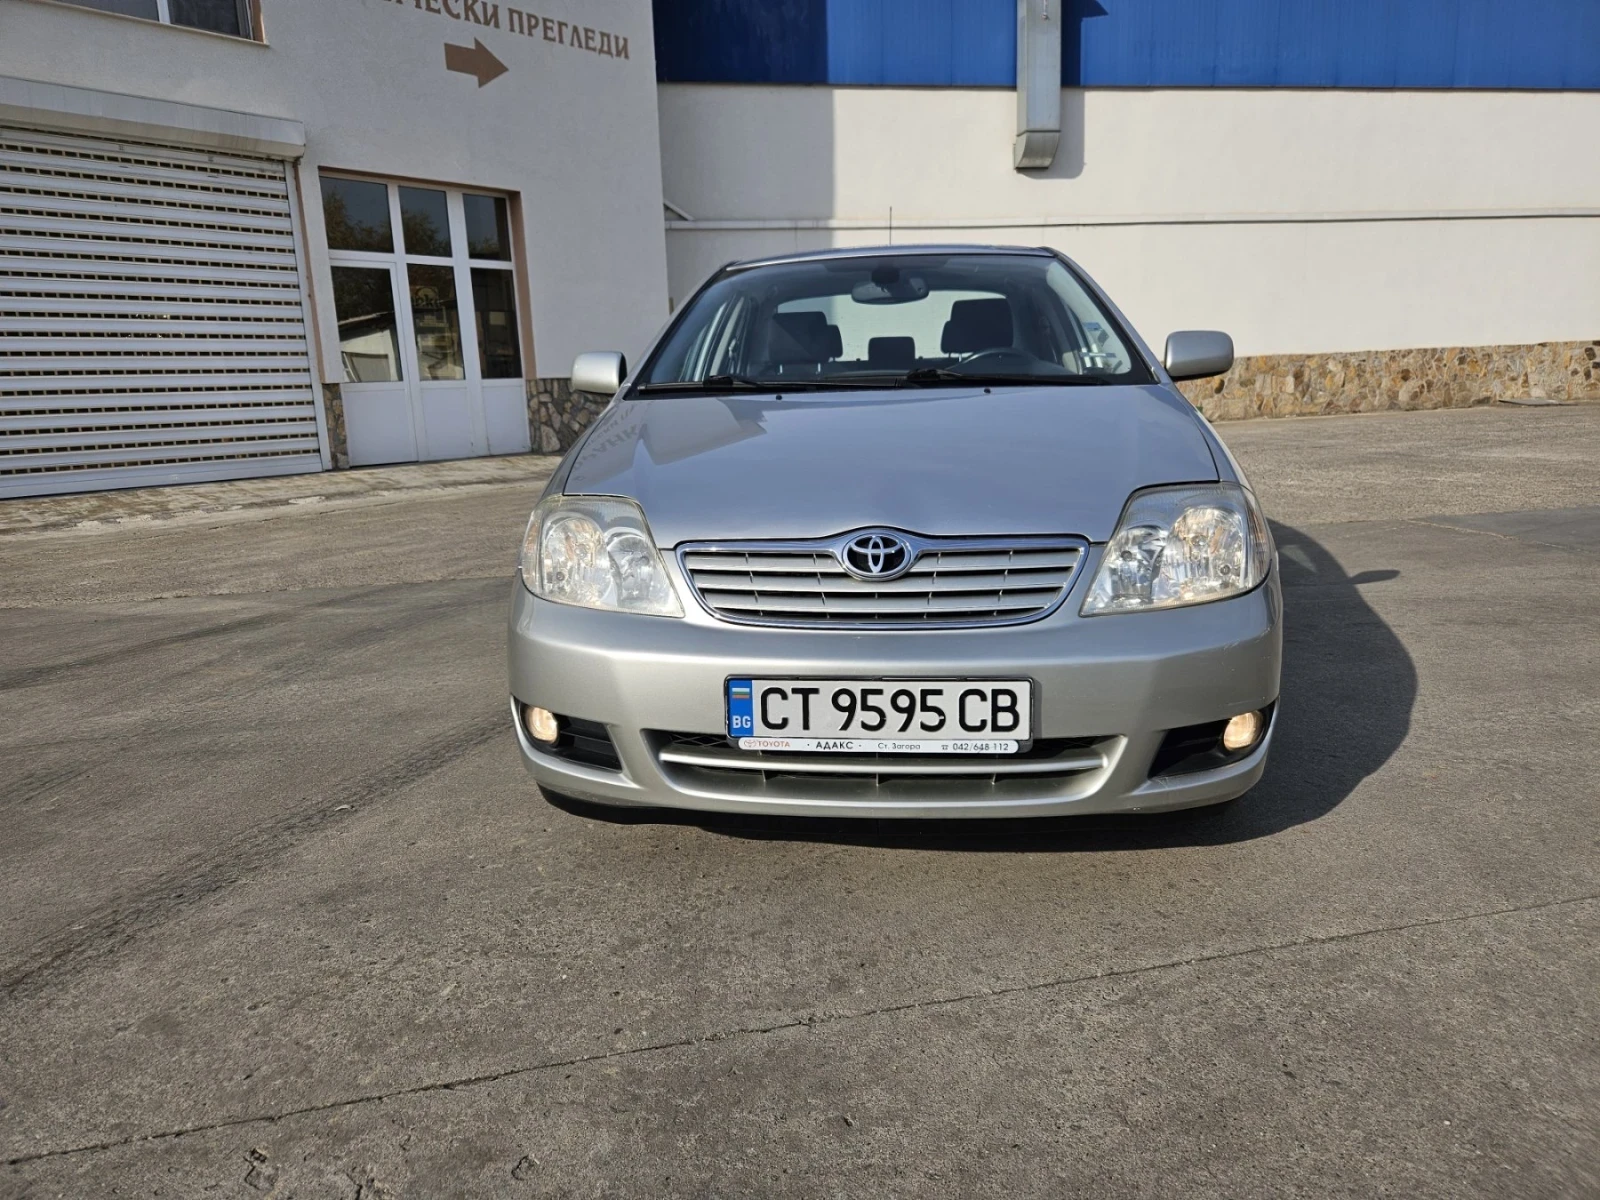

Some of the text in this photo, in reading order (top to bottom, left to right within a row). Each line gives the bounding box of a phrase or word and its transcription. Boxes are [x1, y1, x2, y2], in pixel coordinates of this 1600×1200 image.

[507, 8, 629, 59] ПРЕГЛЕДИ
[732, 715, 751, 729] BG
[760, 687, 1020, 732] CT 9595 CB
[815, 741, 854, 750] АДАКС
